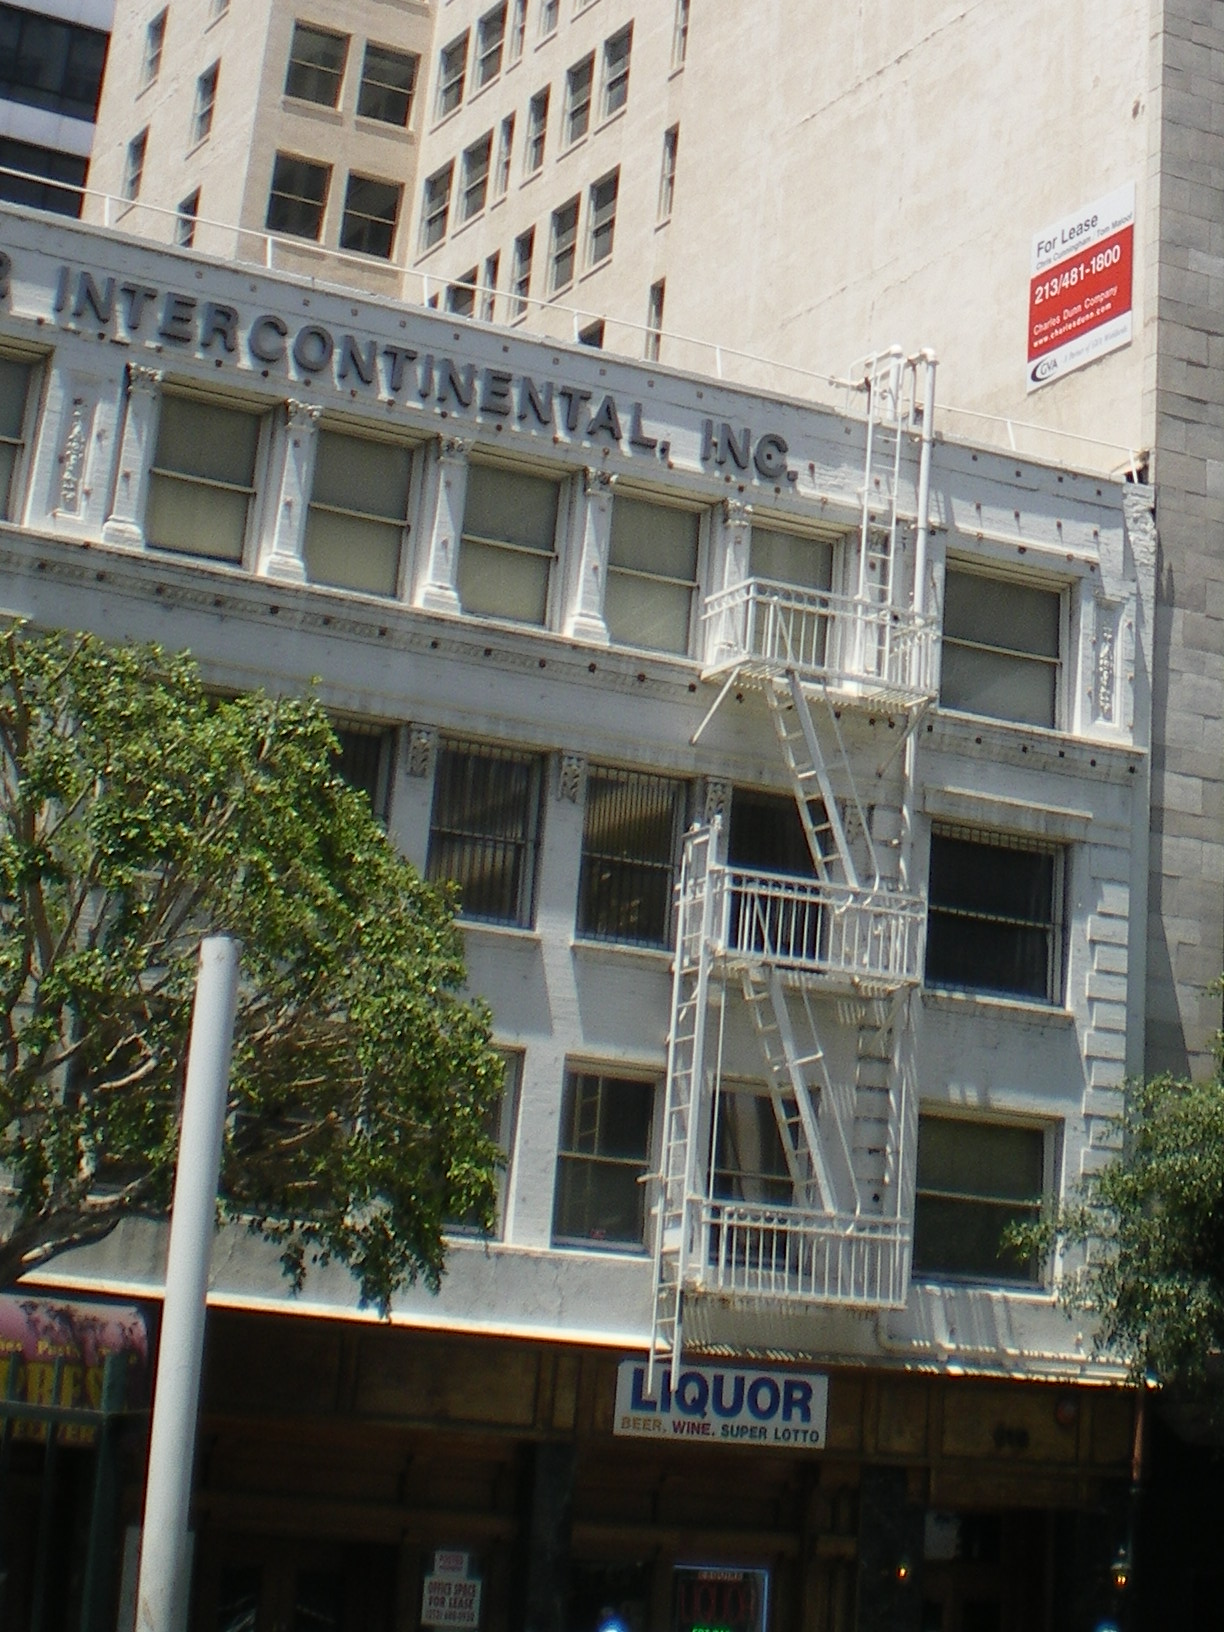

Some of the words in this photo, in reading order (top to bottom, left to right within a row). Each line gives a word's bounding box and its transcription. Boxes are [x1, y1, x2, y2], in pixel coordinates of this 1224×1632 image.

[1036, 237, 1057, 258] For
[1061, 214, 1099, 244] Lease
[1034, 244, 1121, 305] 213/481-1800
[1033, 314, 1061, 336] Charles
[1062, 301, 1082, 321] Dunn
[1084, 285, 1118, 310] Company
[1033, 302, 1112, 348] www.charlesdunn.com
[701, 417, 800, 483] INC.
[631, 1368, 814, 1423] LIQUOR
[721, 1423, 767, 1440] SUPER
[774, 1428, 820, 1443] LOTTO
[428, 1595, 446, 1607] FOR
[448, 1597, 474, 1610] LEASE
